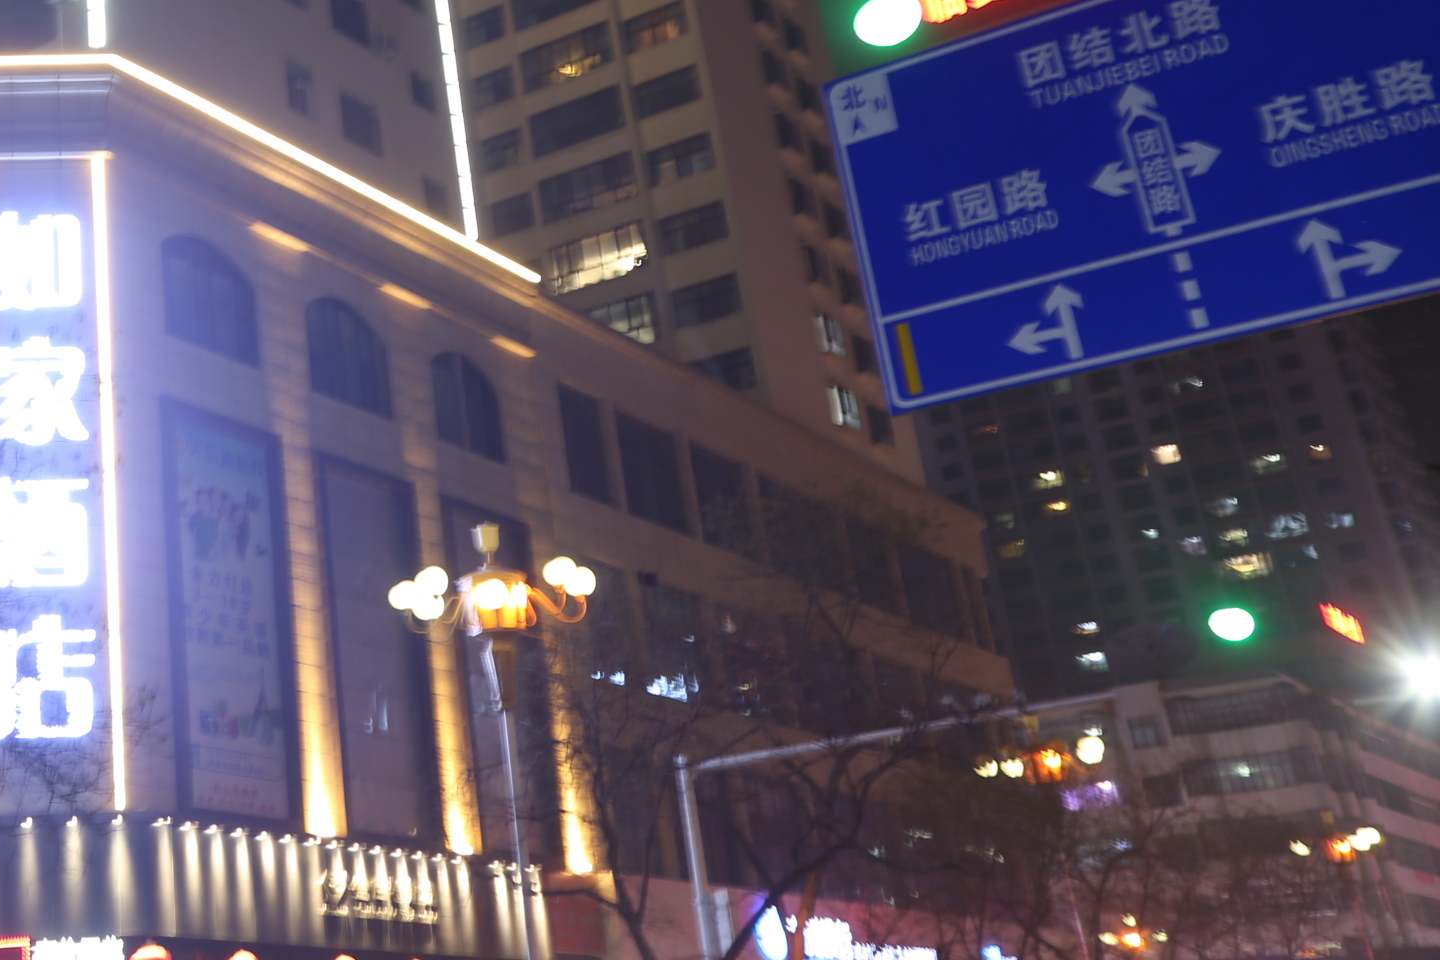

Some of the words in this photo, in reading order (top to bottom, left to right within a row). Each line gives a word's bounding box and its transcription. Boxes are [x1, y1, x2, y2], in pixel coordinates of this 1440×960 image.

[840, 85, 867, 111] 北
[874, 94, 888, 113] N
[1027, 53, 1162, 109] TUANJIEBEI
[1163, 32, 1230, 70] ROAD
[1260, 59, 1435, 144] 庆胜路
[904, 168, 1048, 242] 红园路
[1134, 128, 1181, 216] 团结路
[911, 222, 1009, 267] HONGYUAN
[1010, 208, 1059, 240] ROAD
